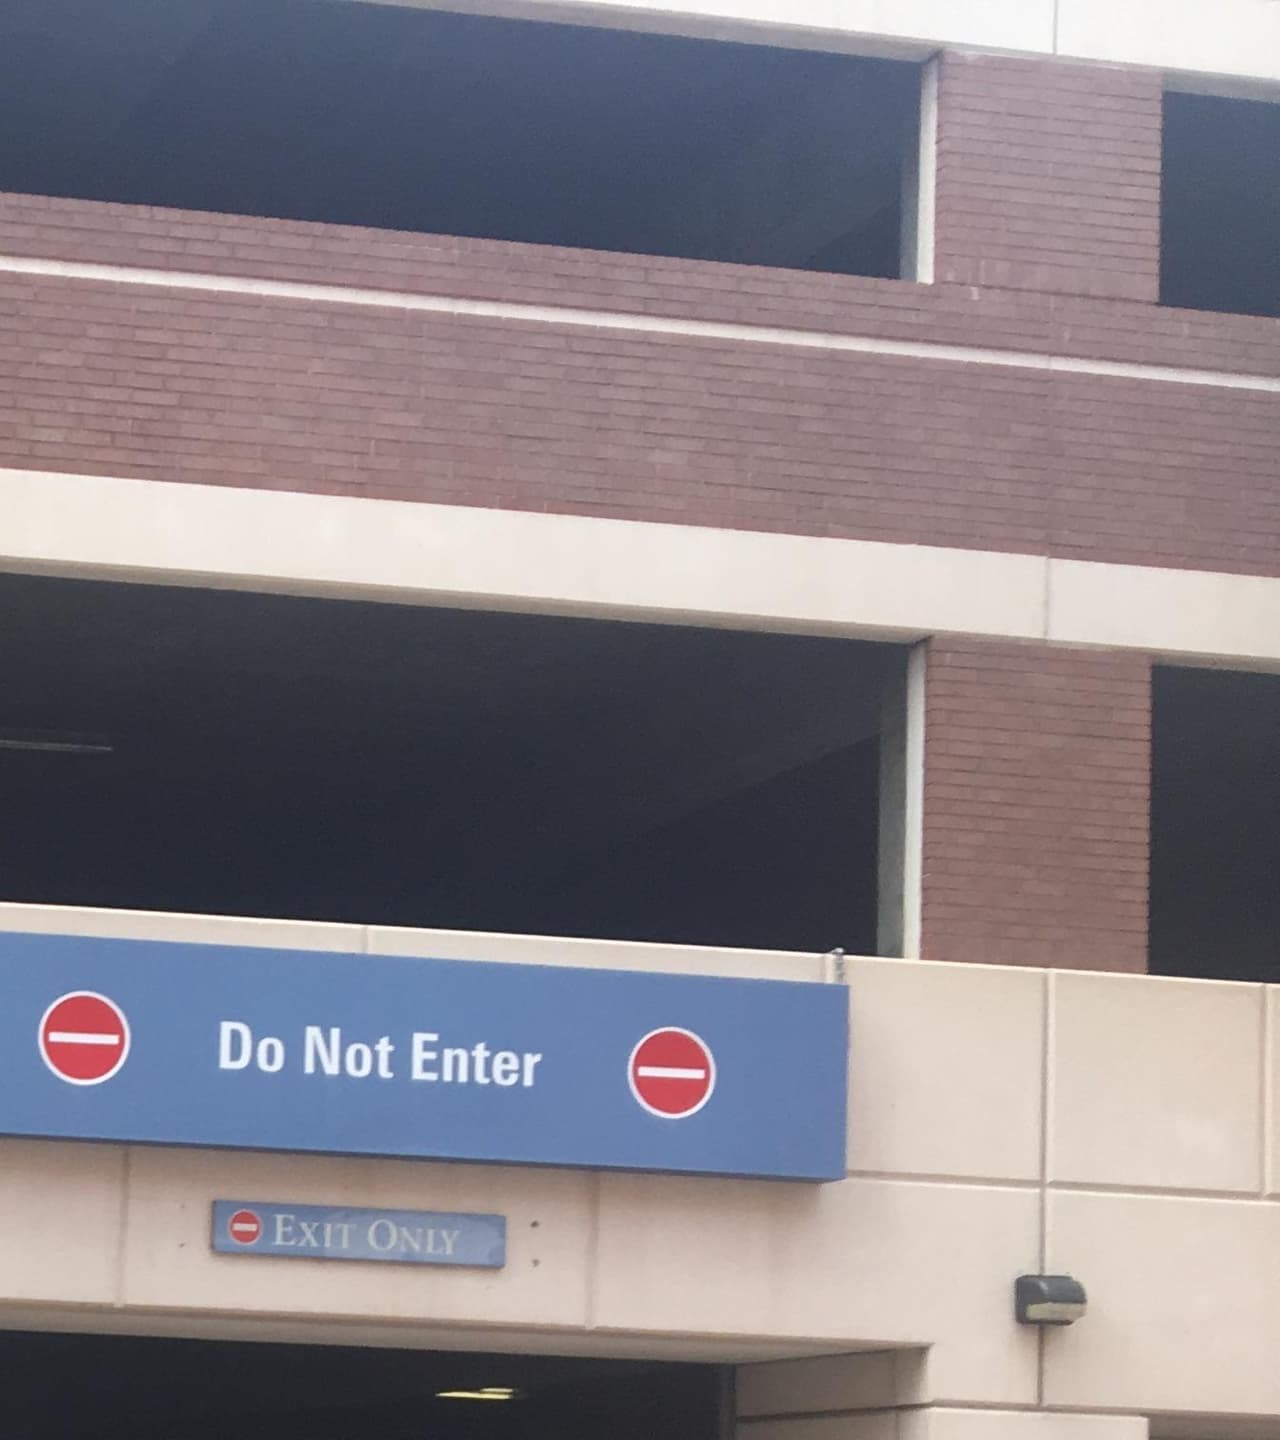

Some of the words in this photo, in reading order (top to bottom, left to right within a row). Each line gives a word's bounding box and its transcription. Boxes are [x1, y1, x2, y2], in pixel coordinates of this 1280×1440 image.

[219, 1020, 285, 1073] Do
[304, 1025, 395, 1079] Not
[411, 1032, 542, 1087] Enter
[272, 1213, 354, 1252] EXIT
[368, 1217, 461, 1256] ONLY
